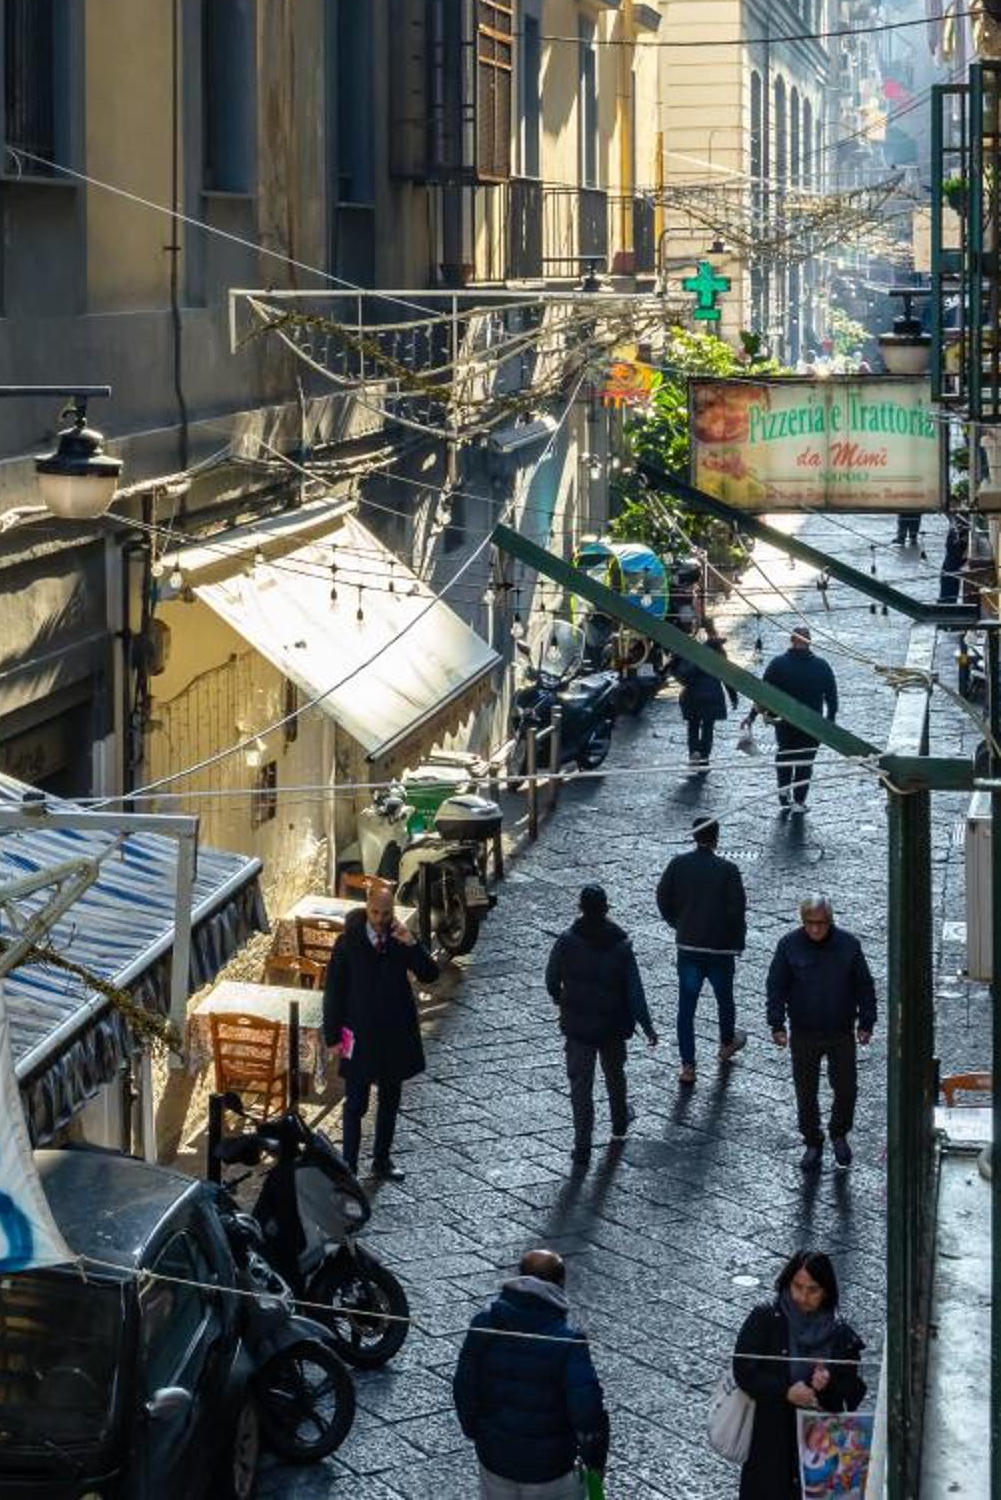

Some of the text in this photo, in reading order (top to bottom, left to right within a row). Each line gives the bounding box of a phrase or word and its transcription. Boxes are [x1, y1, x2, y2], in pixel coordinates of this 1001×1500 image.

[749, 391, 936, 444] Pizzeria e Trattoria
[797, 448, 823, 467] da
